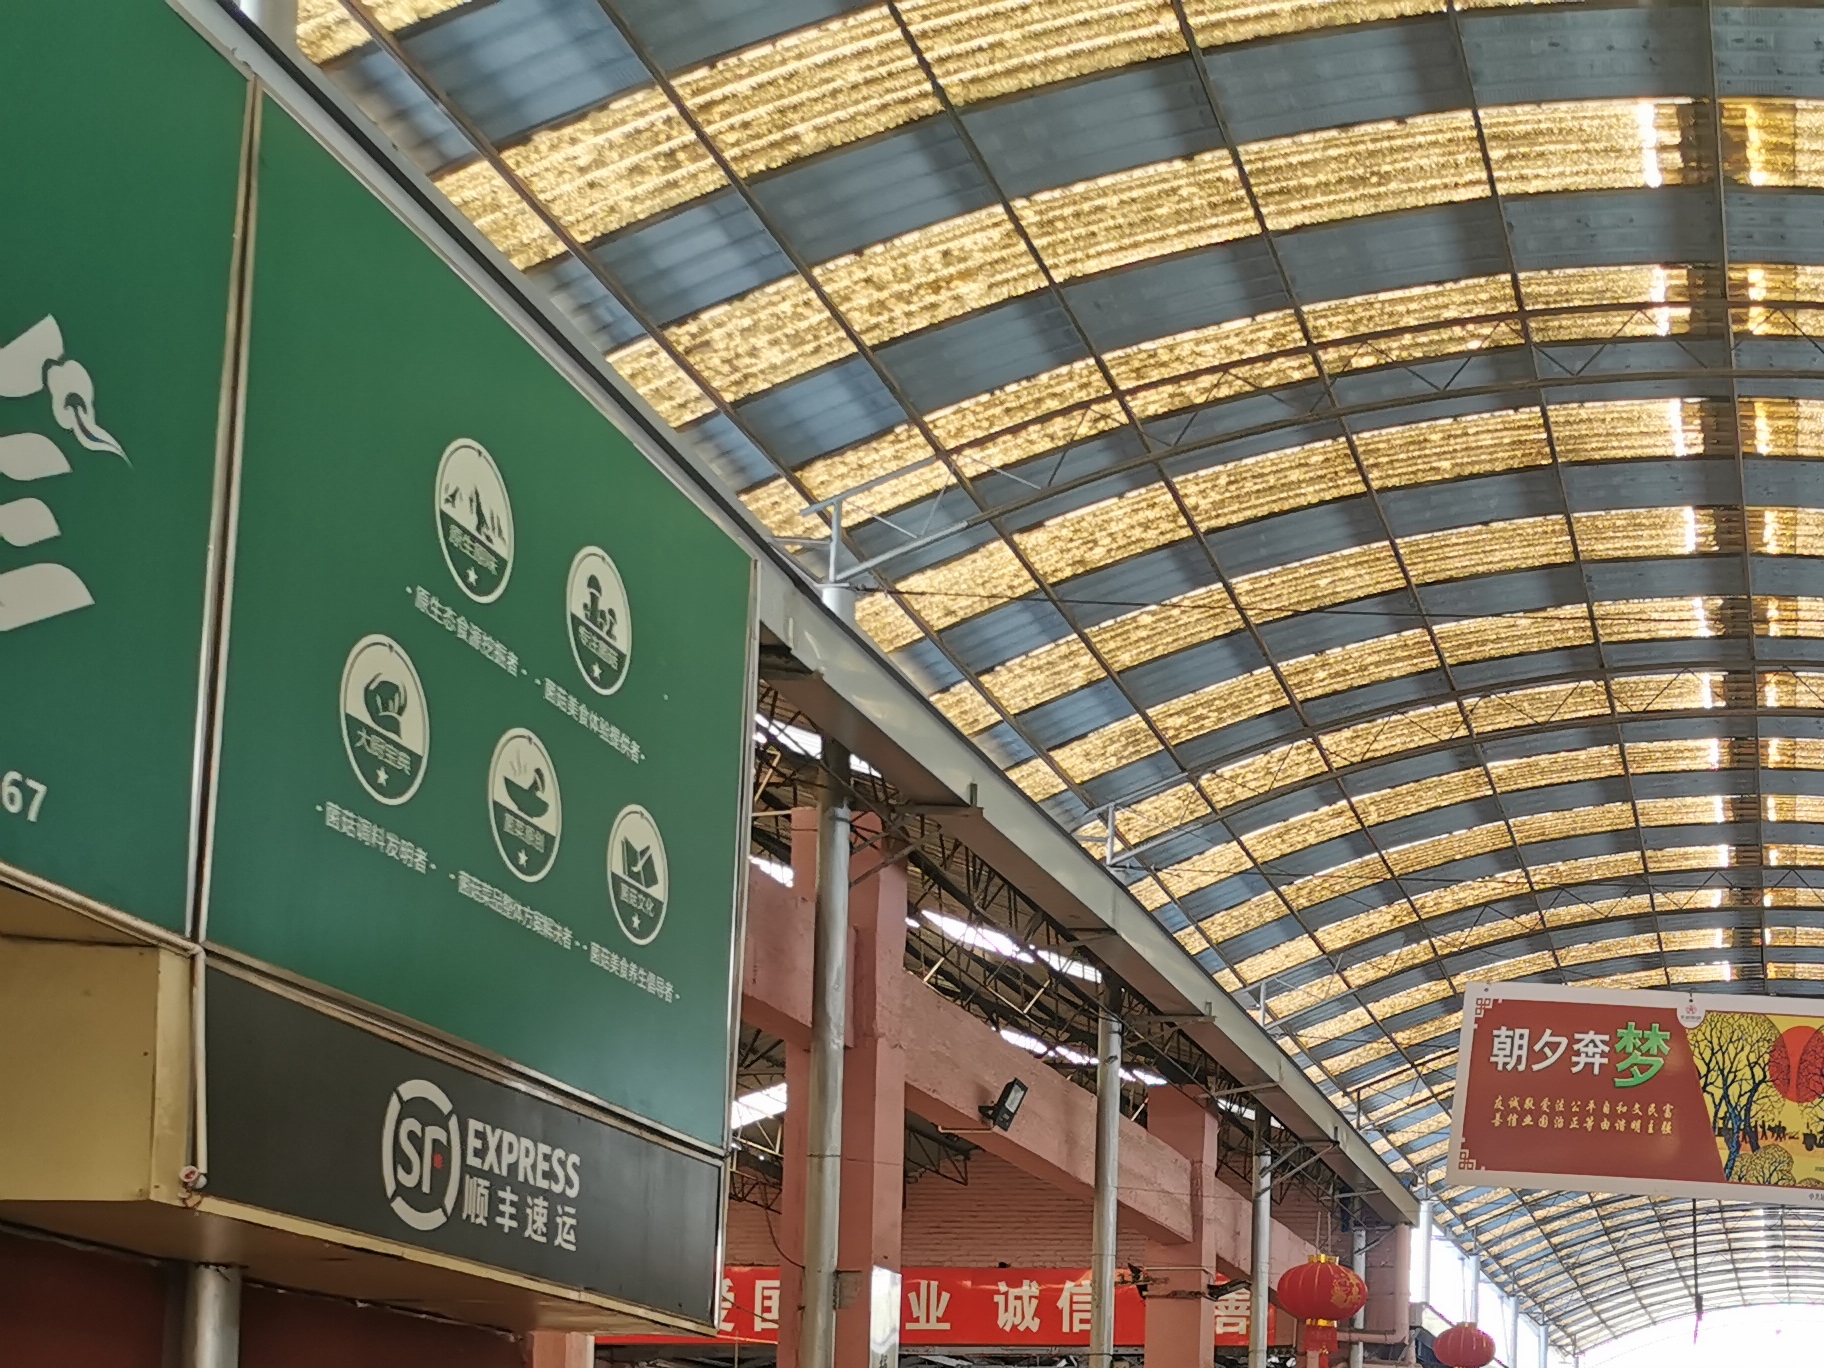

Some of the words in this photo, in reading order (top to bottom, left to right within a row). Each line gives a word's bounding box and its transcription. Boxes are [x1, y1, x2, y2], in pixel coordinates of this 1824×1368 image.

[2, 770, 47, 822] 67
[325, 800, 428, 875] 菌菇调料发明者
[1490, 1021, 1672, 1088] 朝夕奔梦
[466, 1118, 581, 1198] EXPRESS
[461, 1174, 577, 1252] 顺丰速运
[993, 1279, 1091, 1333] 诚信
